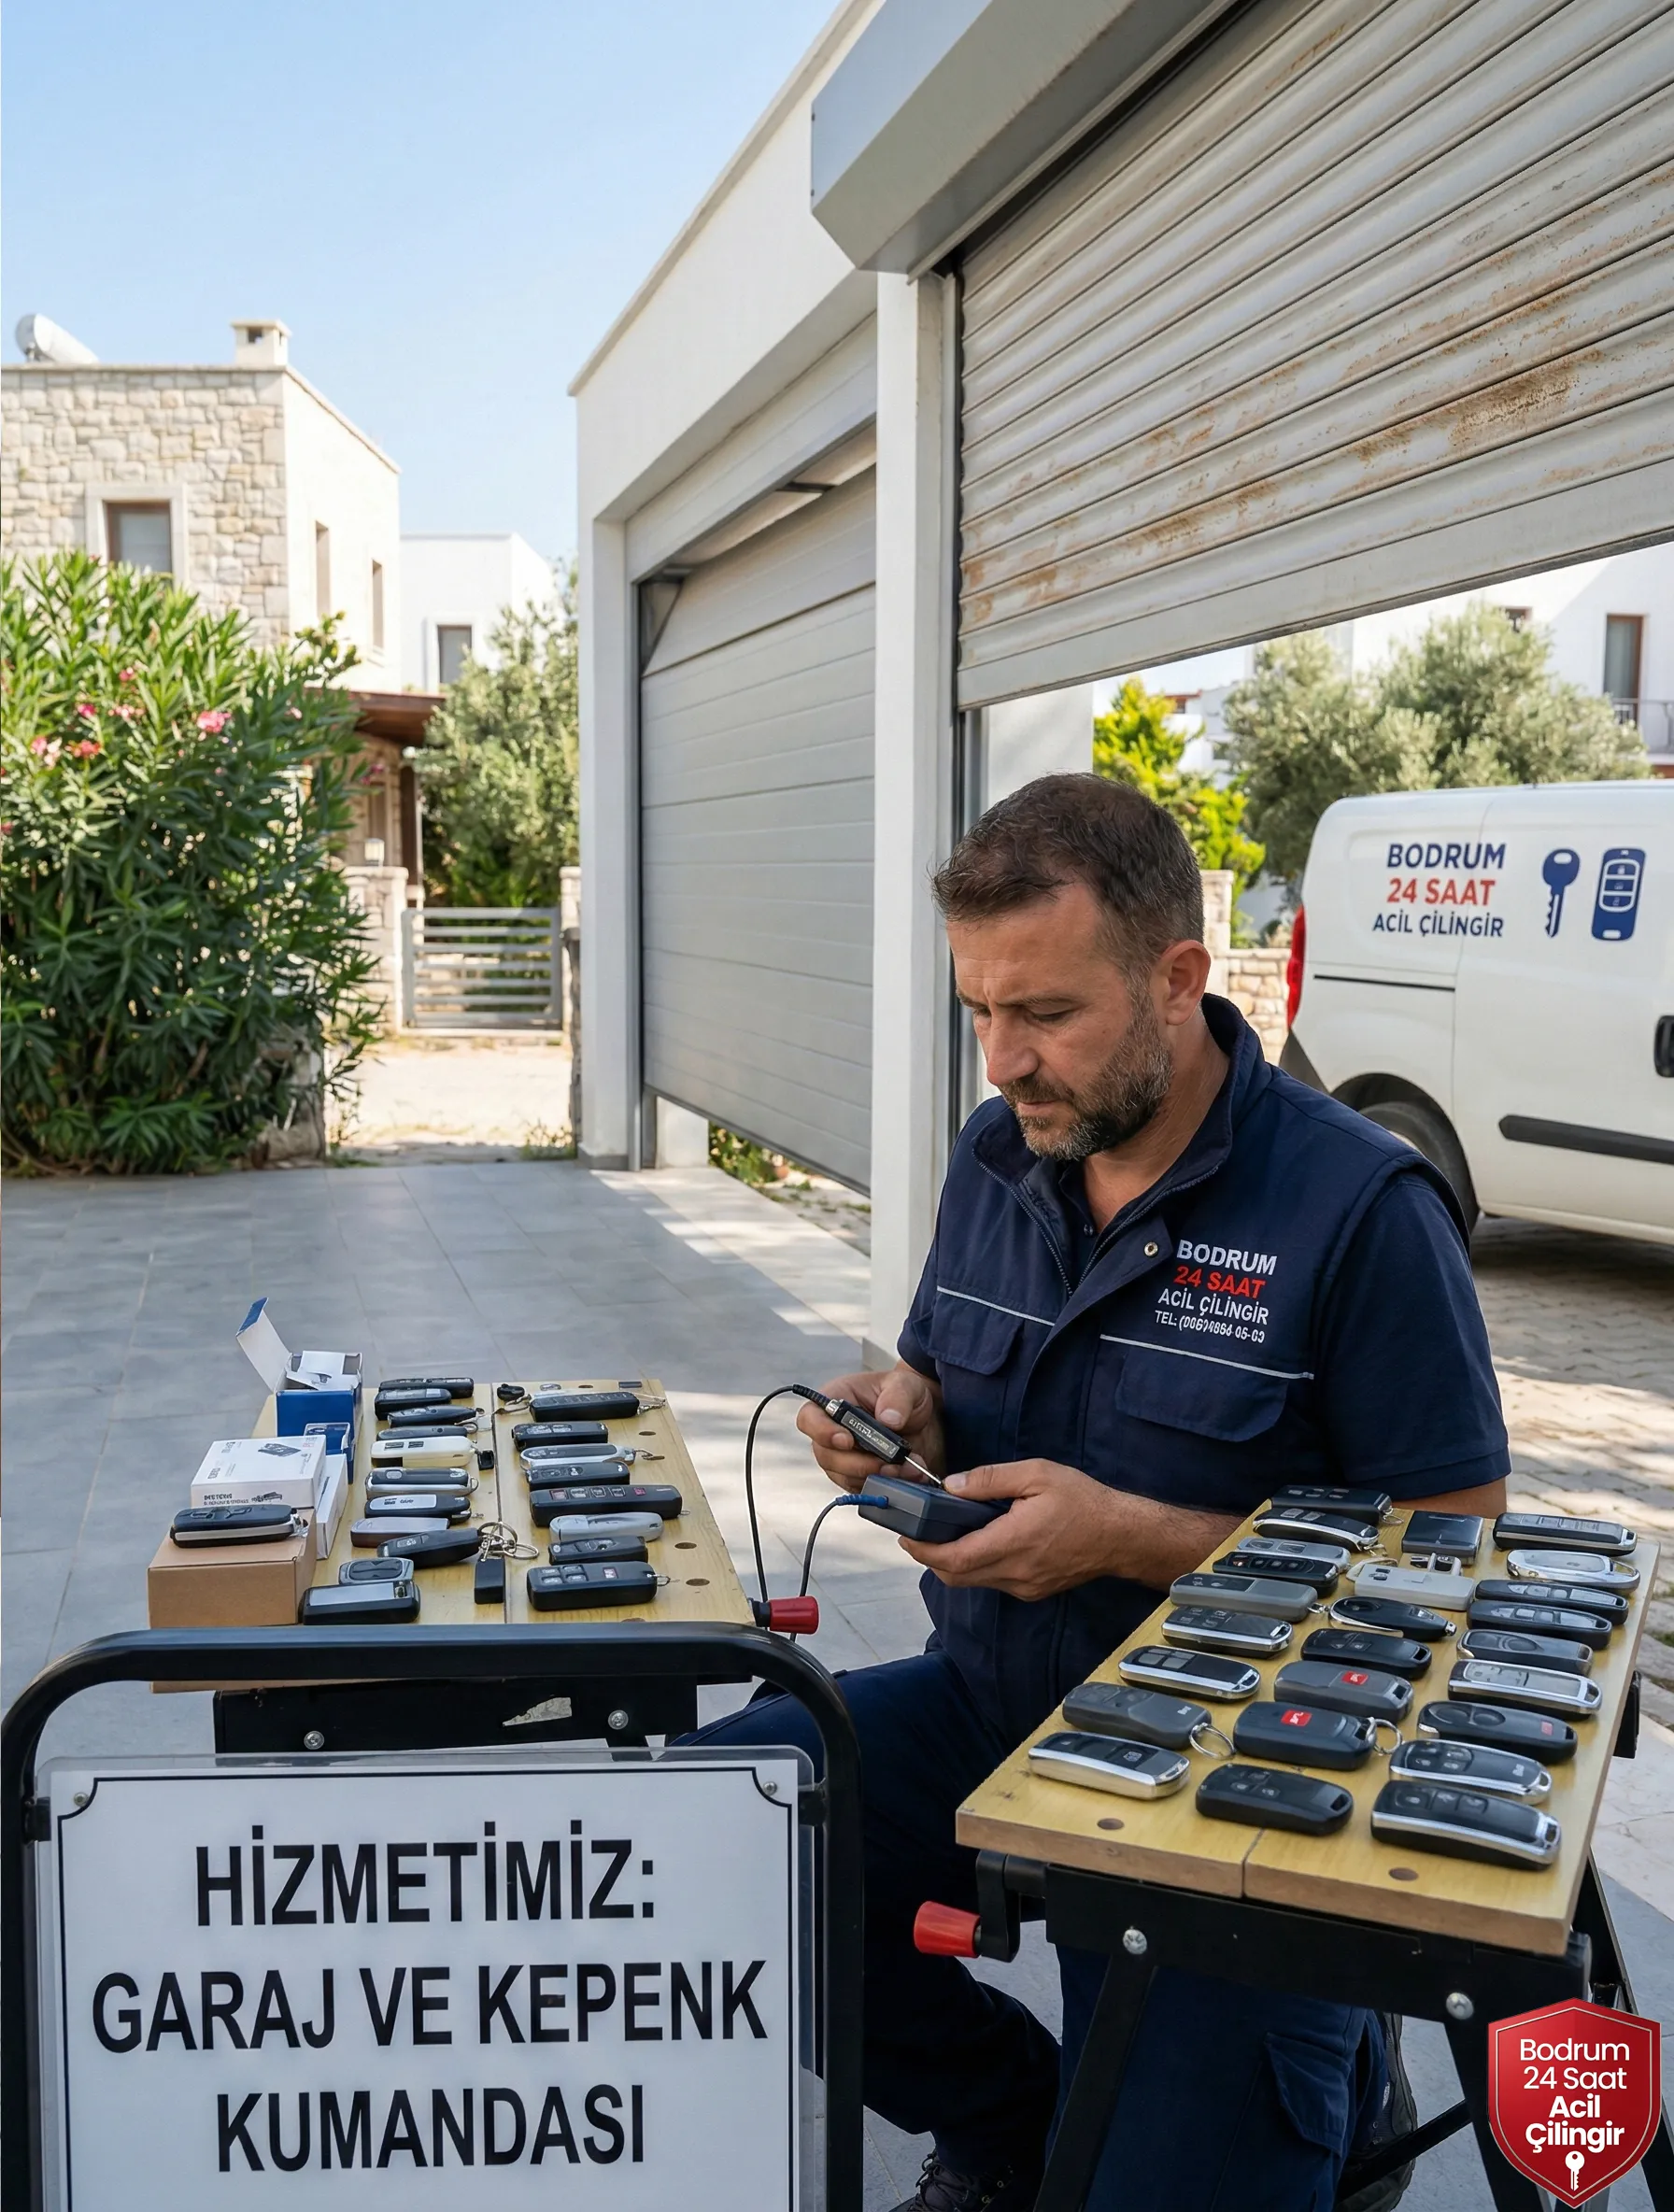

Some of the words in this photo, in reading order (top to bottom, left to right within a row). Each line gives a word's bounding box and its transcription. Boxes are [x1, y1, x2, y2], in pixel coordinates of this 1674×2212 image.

[1386, 843, 1507, 870] BODRUM
[1386, 877, 1418, 904] 24
[1425, 878, 1497, 907] SAAT
[1372, 909, 1412, 933] ACİL
[1419, 910, 1504, 937] ÇİLİNGİR
[1176, 1239, 1277, 1275] BODRUM
[1173, 1266, 1202, 1288] 24
[1207, 1270, 1266, 1298] SAAT
[1157, 1287, 1194, 1311] ACİL
[1199, 1293, 1270, 1325] ÇİLİNGİR
[195, 1819, 654, 1927] HİZMETİMİZ:
[92, 1966, 335, 2054] GARAJ
[359, 1966, 453, 2048] VE
[478, 1960, 769, 2046] KEPENK
[217, 2083, 644, 2173] KUMANDASI
